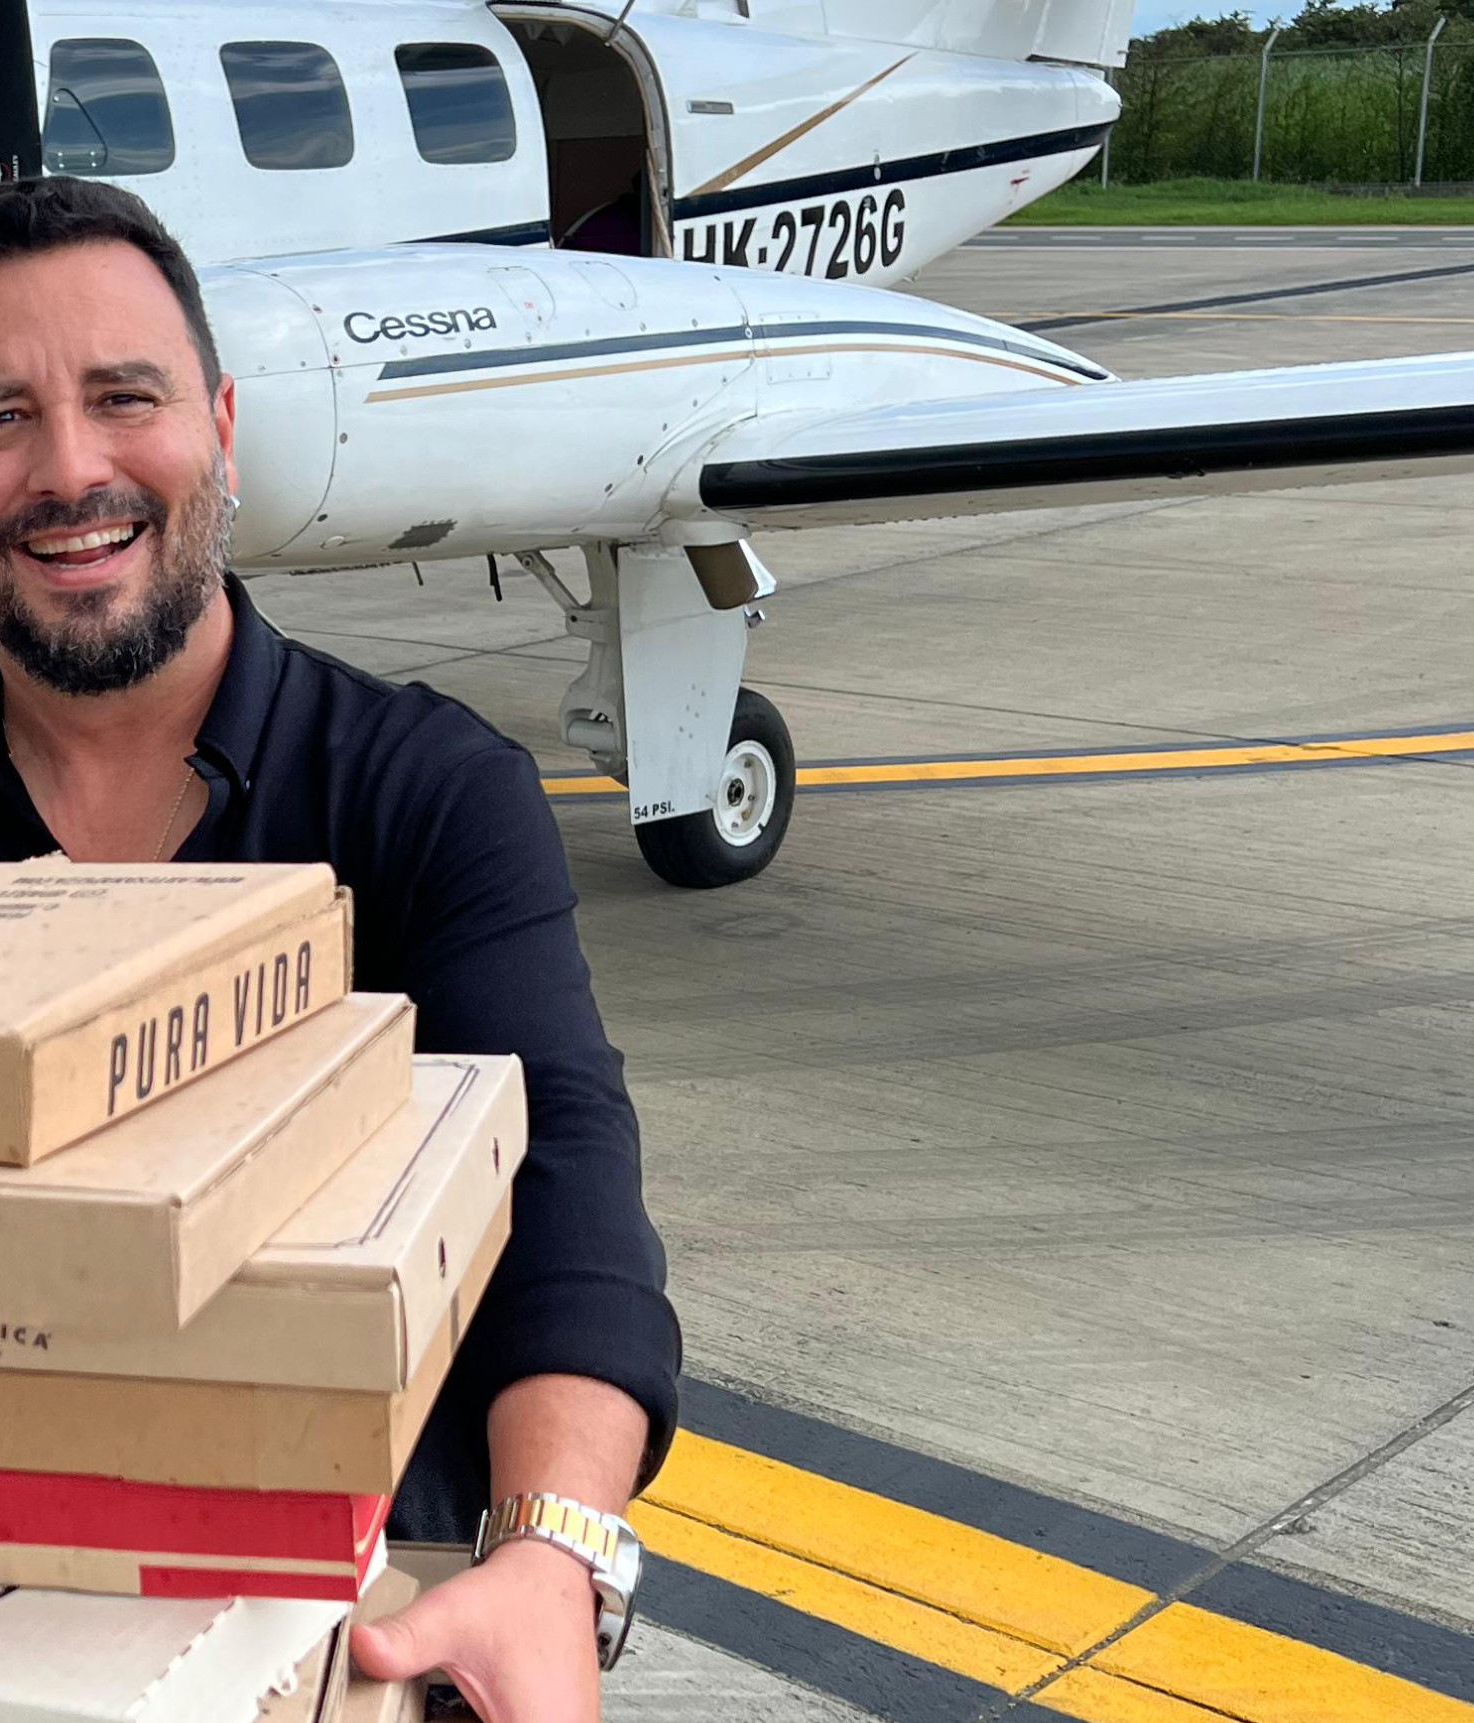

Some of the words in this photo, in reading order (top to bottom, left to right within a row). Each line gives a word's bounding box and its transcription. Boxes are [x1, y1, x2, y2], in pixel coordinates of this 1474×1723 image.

[683, 188, 905, 279] HK-2726G
[343, 307, 497, 343] Cessna
[634, 805, 648, 819] 54
[107, 991, 209, 1116] PURA
[234, 940, 310, 1047] VIDA
